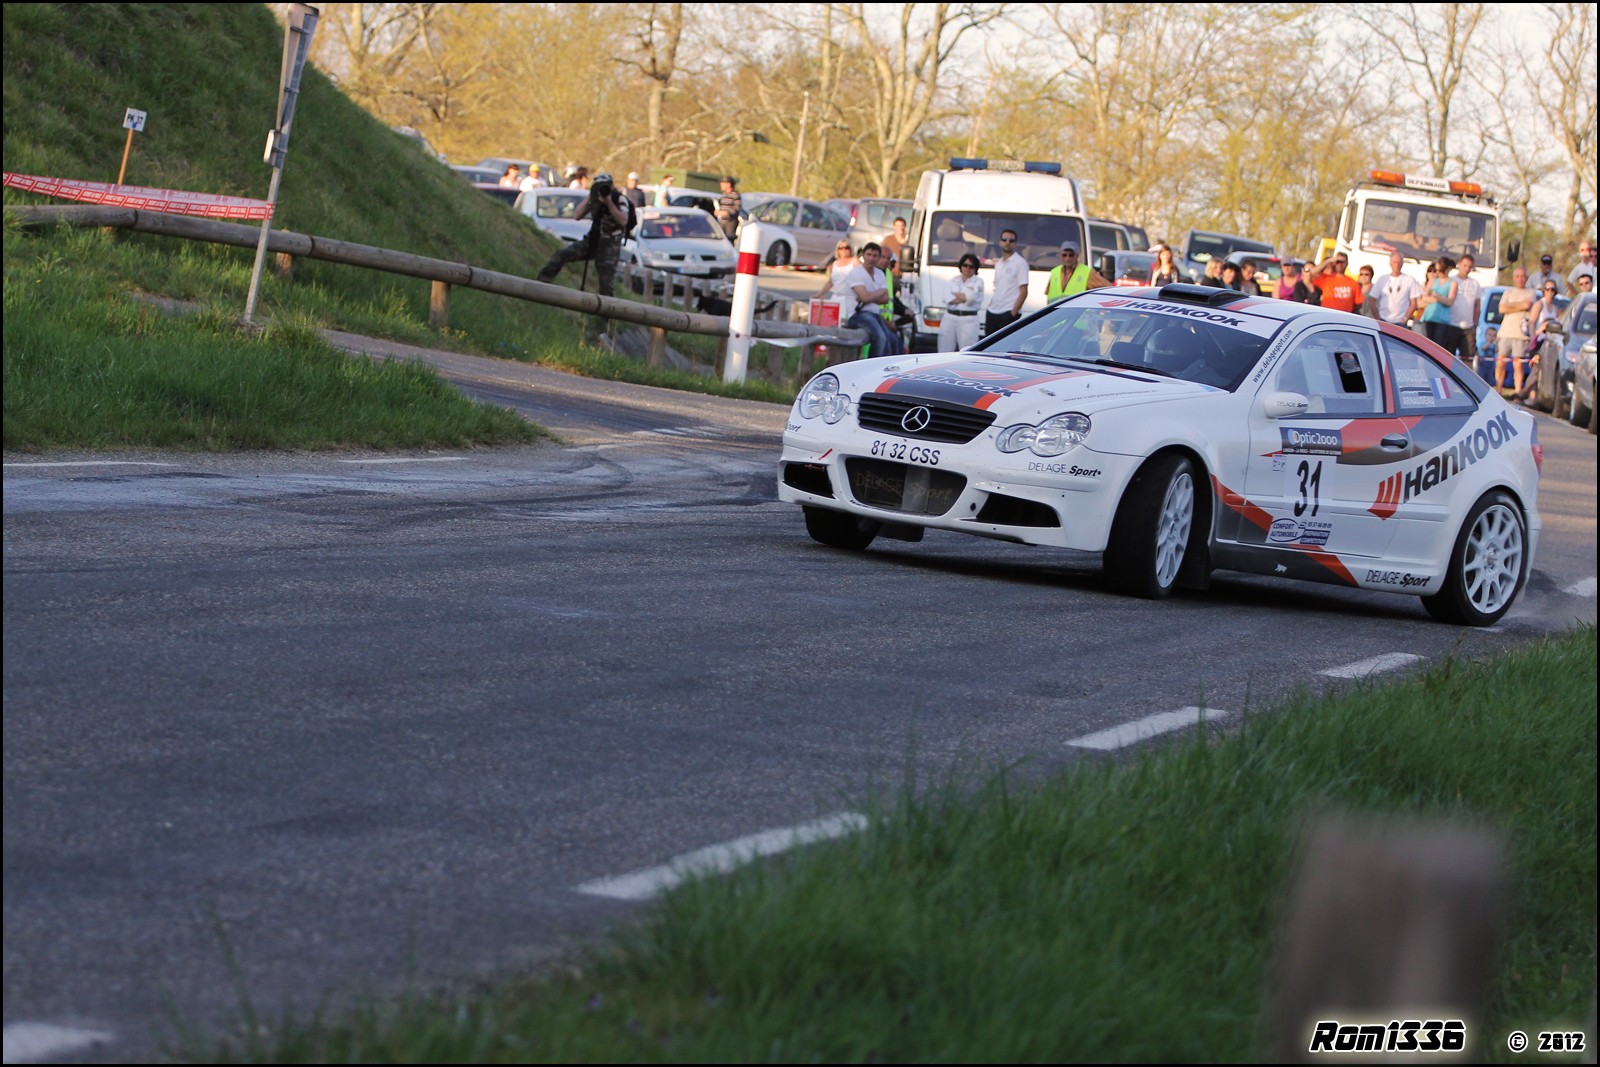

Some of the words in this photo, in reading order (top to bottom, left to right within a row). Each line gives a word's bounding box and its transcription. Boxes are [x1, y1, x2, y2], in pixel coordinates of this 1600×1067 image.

[1252, 329, 1293, 383] www.delagesport.com
[871, 440, 887, 457] 81
[890, 443, 907, 460] 32
[909, 446, 941, 466] CSS
[1028, 461, 1067, 474] DELAGE
[1068, 465, 1098, 477] Sport
[856, 470, 904, 491] DELAGE
[1294, 460, 1323, 517] 31
[1272, 522, 1295, 530] CONFORT
[1365, 569, 1401, 584] DELAGE
[1399, 573, 1431, 588] Sport
